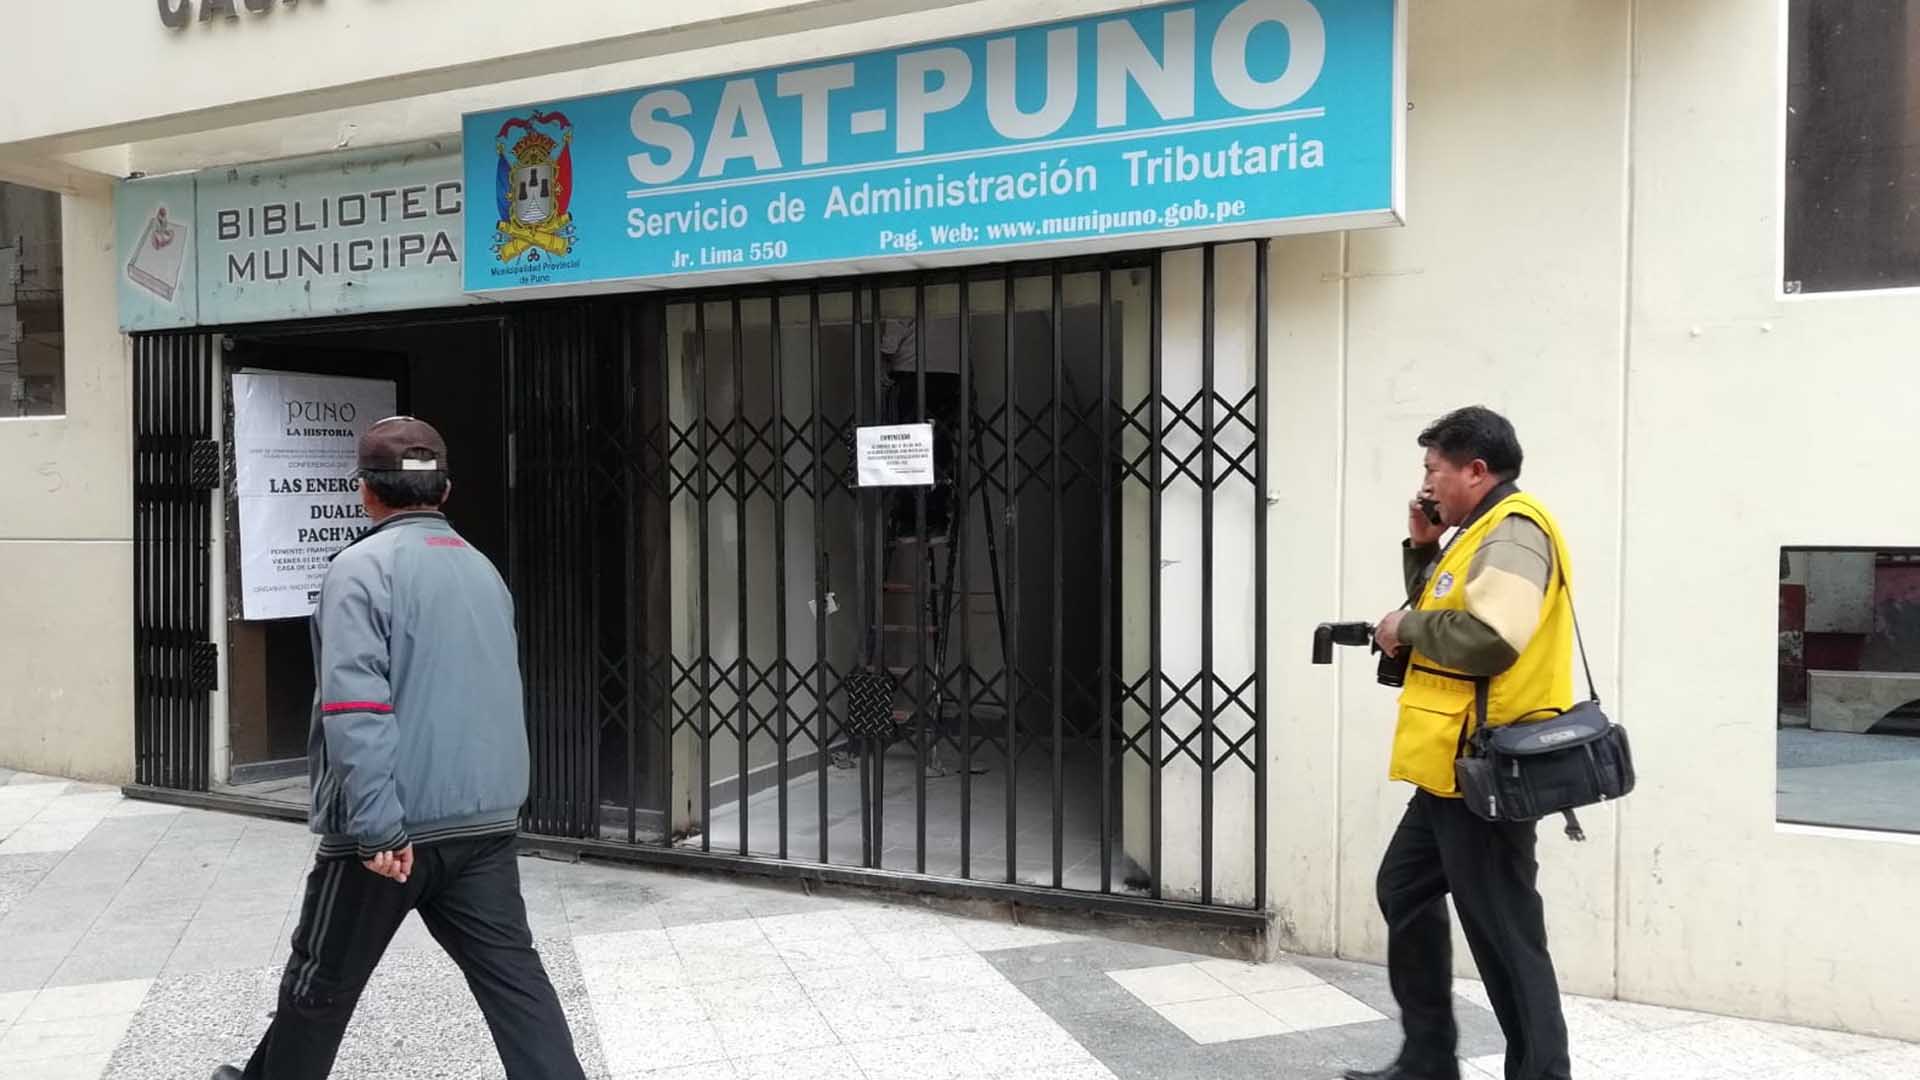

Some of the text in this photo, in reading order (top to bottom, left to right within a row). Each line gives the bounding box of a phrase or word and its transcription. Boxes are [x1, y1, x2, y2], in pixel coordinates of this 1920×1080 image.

[627, 0, 1326, 185] SAT-PUNO
[217, 182, 462, 240] BIBLIOTEC
[627, 132, 1325, 238] Servicio de Administración Tributaria
[879, 198, 1246, 252] Pag. Web: www.munipuno.gob.pe
[228, 231, 458, 283] MUNICIPA
[671, 240, 788, 268] Jr. Lima 550
[286, 428, 354, 438] LA HISTORIA
[287, 400, 356, 424] PUNO
[269, 478, 302, 493] LAS
